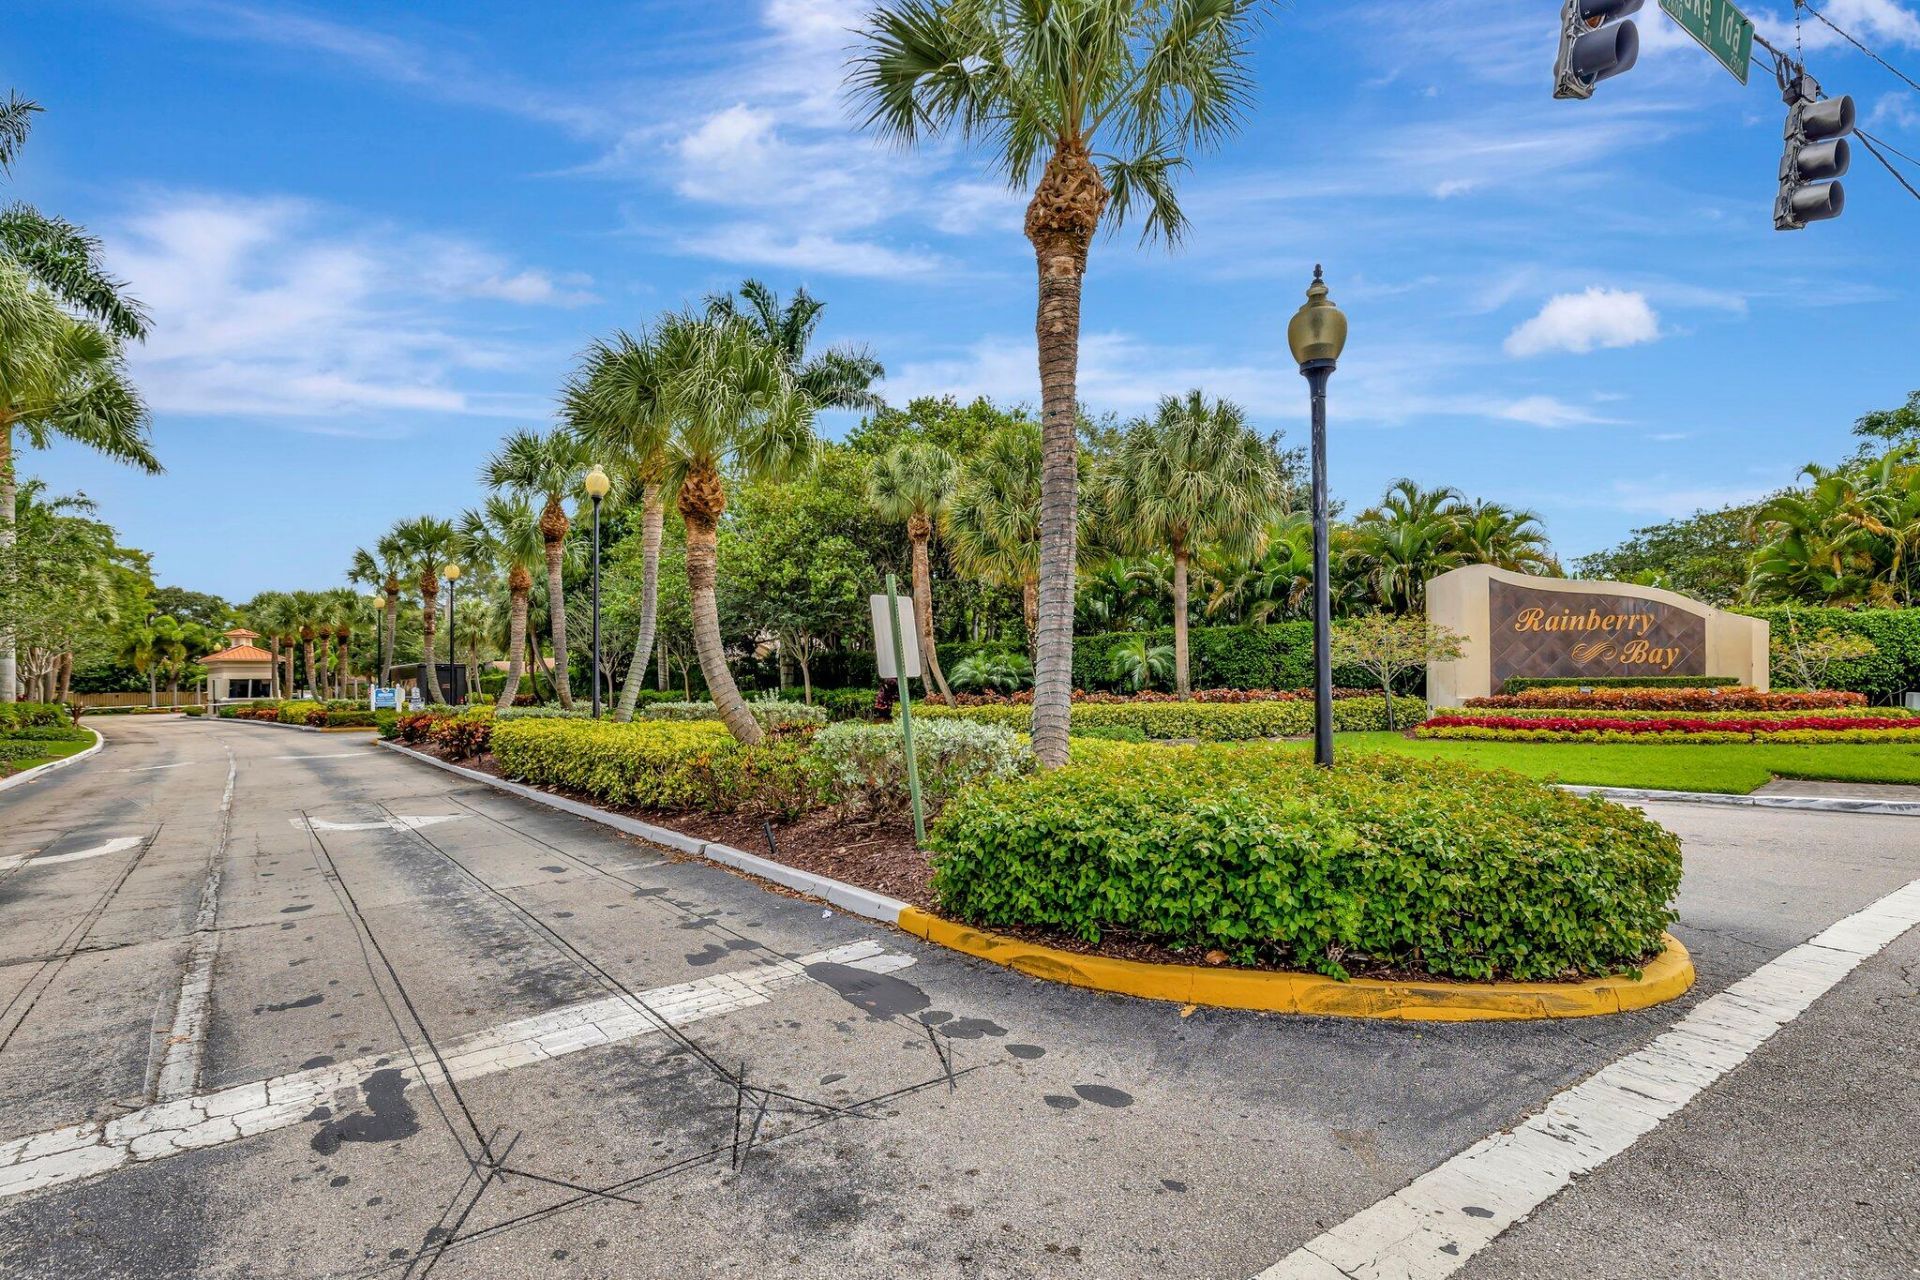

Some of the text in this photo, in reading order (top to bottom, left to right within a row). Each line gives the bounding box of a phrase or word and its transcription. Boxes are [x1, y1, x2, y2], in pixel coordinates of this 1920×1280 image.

[1719, 1, 1741, 53] Ida
[1514, 607, 1655, 636] Rainberry
[1620, 639, 1679, 670] Bay
